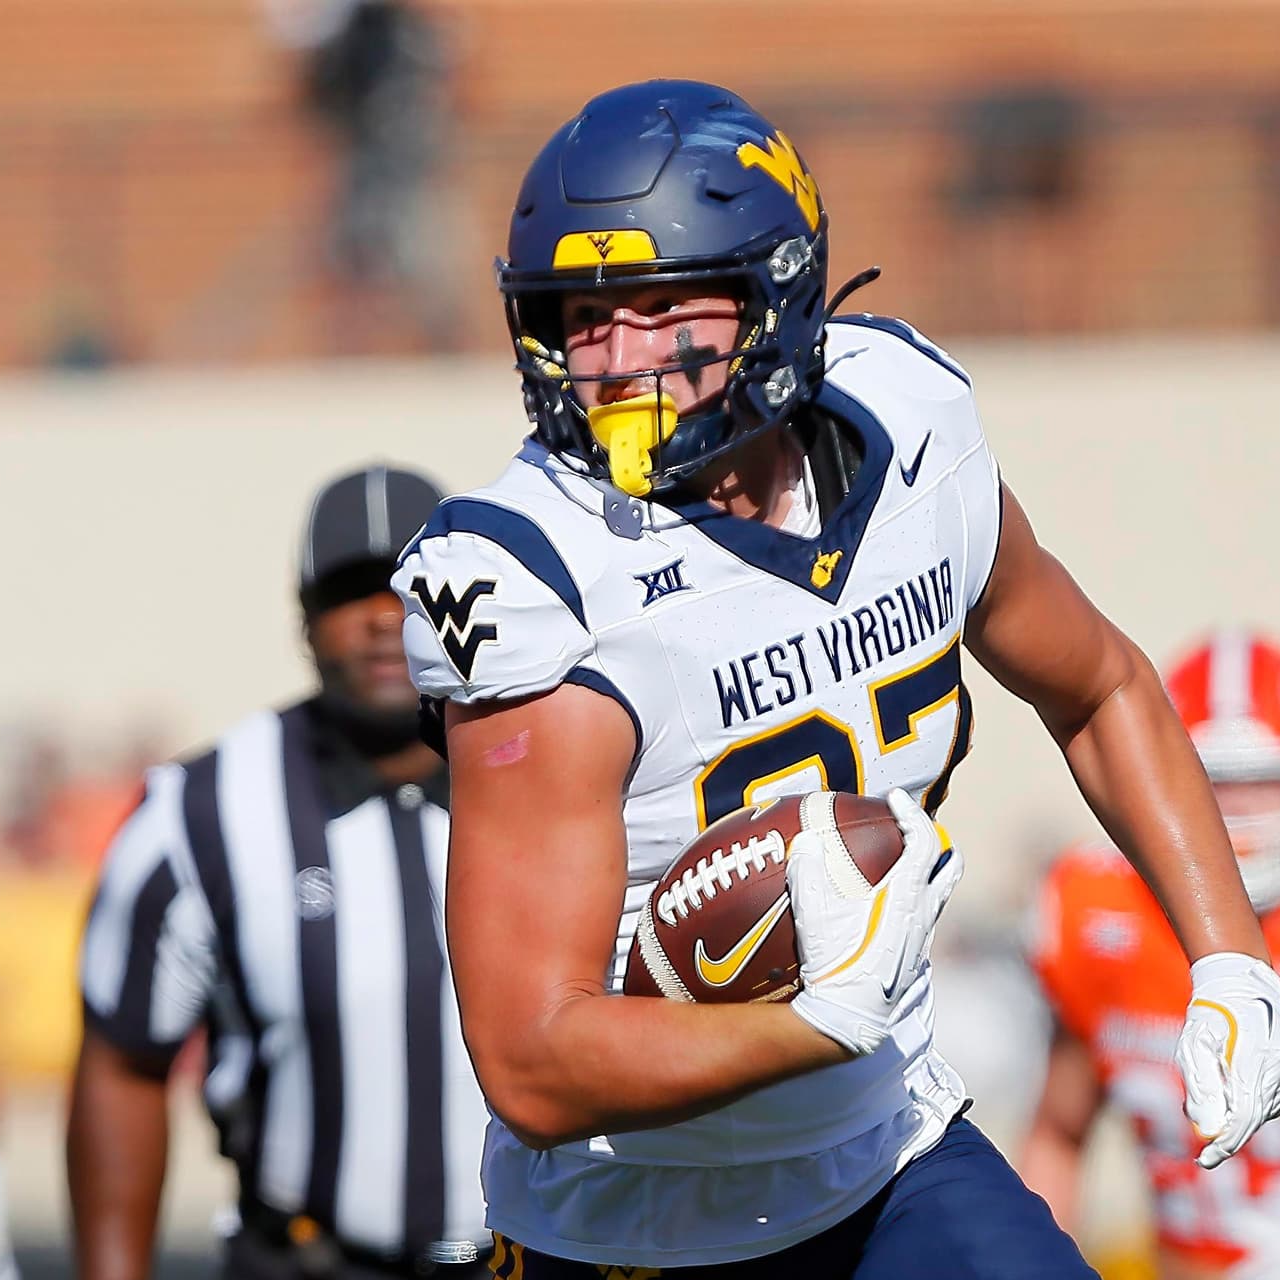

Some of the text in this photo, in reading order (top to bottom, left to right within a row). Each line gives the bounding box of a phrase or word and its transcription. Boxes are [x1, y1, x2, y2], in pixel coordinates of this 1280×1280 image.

[633, 555, 697, 607] XII
[712, 556, 955, 728] WEST VIRGINIA
